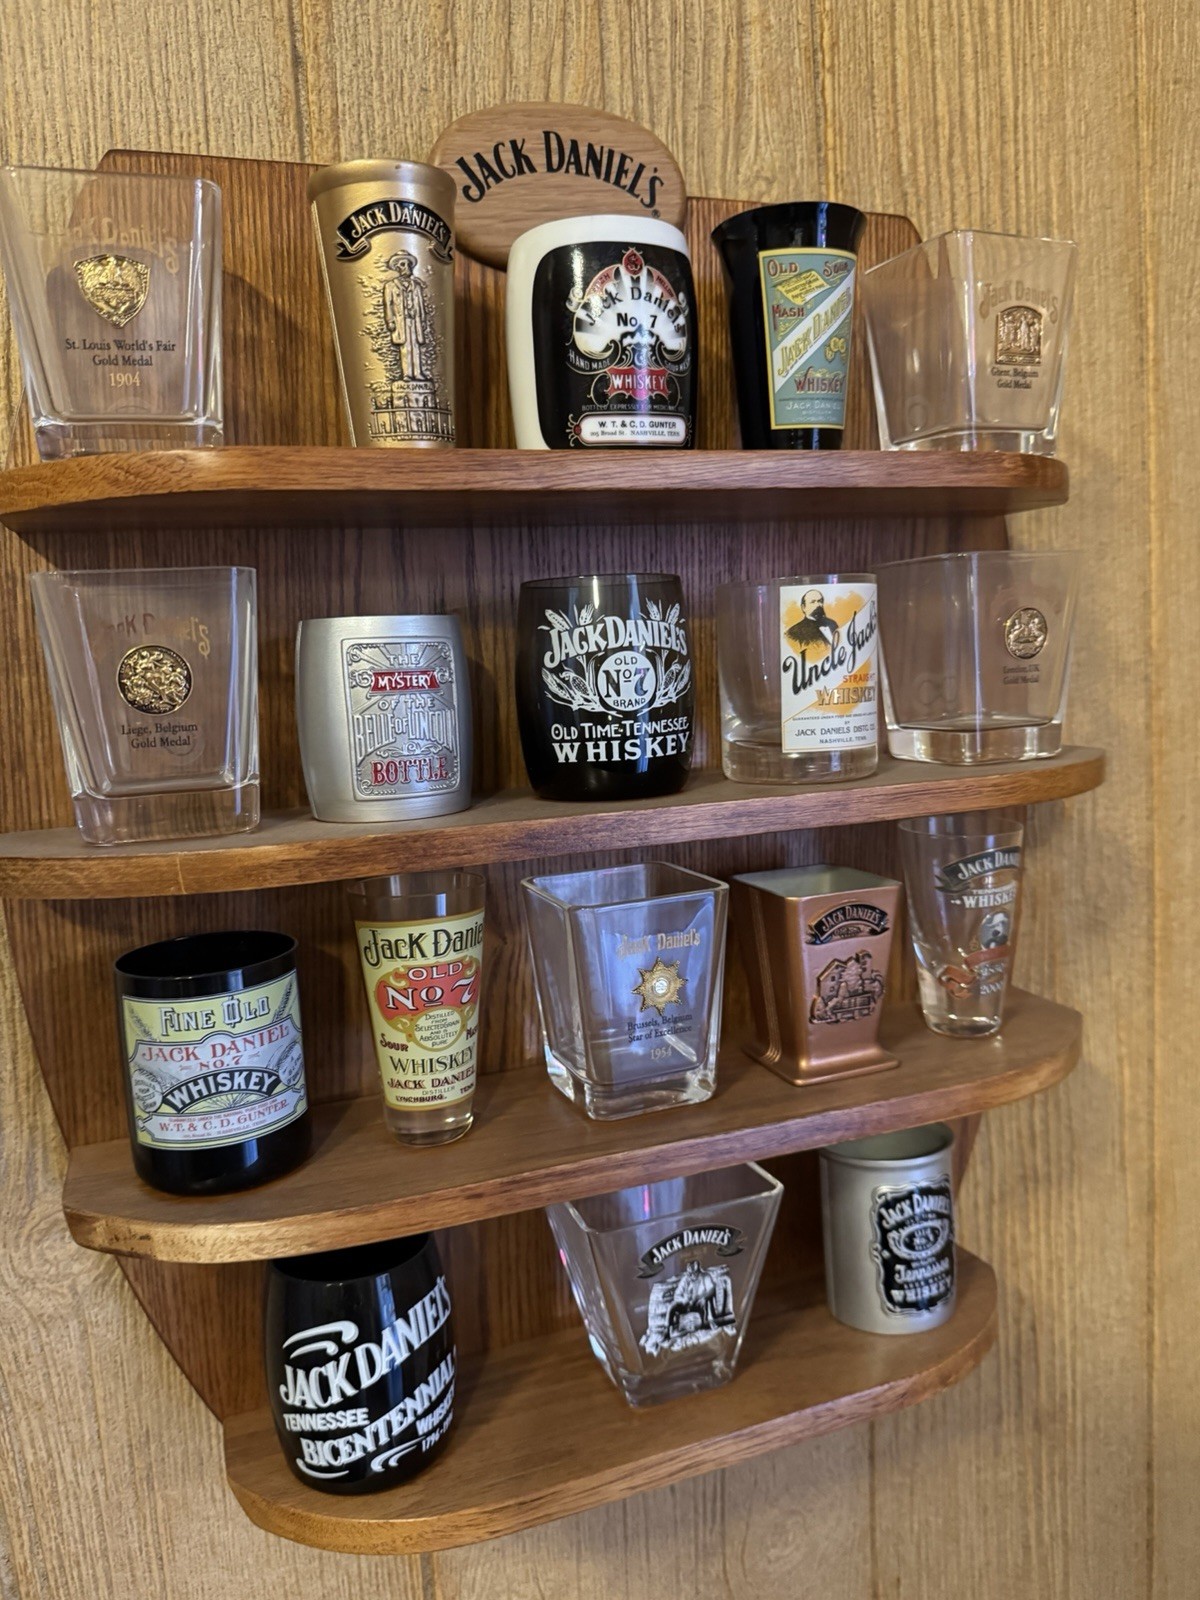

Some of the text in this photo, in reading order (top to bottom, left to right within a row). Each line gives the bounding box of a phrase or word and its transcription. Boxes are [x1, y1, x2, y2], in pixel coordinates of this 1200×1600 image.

[455, 138, 538, 202] JACK
[350, 208, 389, 238] JACK
[767, 259, 799, 276] OLD
[649, 314, 658, 329] 7
[772, 303, 805, 331] MASH
[64, 338, 177, 352] St. Louis World's Fair
[777, 326, 812, 378] JACK
[92, 354, 153, 367] Gold Medal
[568, 349, 611, 371] HAND MADE
[109, 371, 141, 388] 1904
[611, 373, 666, 390] WHISKEY
[794, 366, 846, 394] WHISKEY
[620, 420, 628, 428] &
[649, 420, 677, 429] GUNTER
[543, 615, 688, 669] JACK DANIEL'S
[782, 600, 878, 696] Uncle Jack
[389, 653, 421, 666] THE
[614, 655, 638, 666] OLD
[377, 671, 434, 691] MYSTERY
[634, 667, 651, 697] 7
[378, 696, 435, 711] OF THE
[613, 697, 646, 710] BRAND
[155, 722, 198, 735] Belgium
[353, 708, 457, 767] BELLE OF LINCOLN
[551, 716, 690, 740] OLD TIME TENNESSEE
[795, 728, 817, 737] JACK
[131, 735, 191, 749] Gold Medal
[551, 731, 690, 763] WHISKEY
[371, 756, 449, 788] BOTTLE
[957, 854, 994, 881] JACK
[822, 909, 846, 931] JACK
[363, 928, 428, 967] Jack
[657, 928, 701, 951] Daniel's
[407, 960, 463, 981] OLD
[451, 973, 477, 1005] 7
[159, 994, 270, 1037] FINE OLD
[425, 1010, 455, 1021] DISTILLED
[627, 1013, 692, 1031] Brussels, Belgium
[142, 1023, 290, 1062] JACK DANIEL
[380, 1032, 409, 1052] SOUR
[419, 1030, 458, 1042] ABSOLUTELY
[628, 1025, 692, 1043] Star of Excellence
[199, 1054, 243, 1071] NO. 7
[388, 1045, 473, 1074] WHISKEY
[164, 1070, 279, 1113] WHISKEY
[387, 1078, 426, 1090] JACK
[422, 1086, 456, 1096] DISTILLER
[187, 1122, 198, 1132] &
[203, 1120, 218, 1131] C.
[220, 1117, 236, 1128] D.
[237, 1099, 288, 1124] GUNTER
[880, 1198, 914, 1230] JACK
[652, 1236, 684, 1264] JACK
[890, 1275, 951, 1303] WHISKEY
[279, 1351, 360, 1411] JACK
[283, 1407, 371, 1432] TENNESSEE
[299, 1350, 456, 1468] BICENTENNIAL
